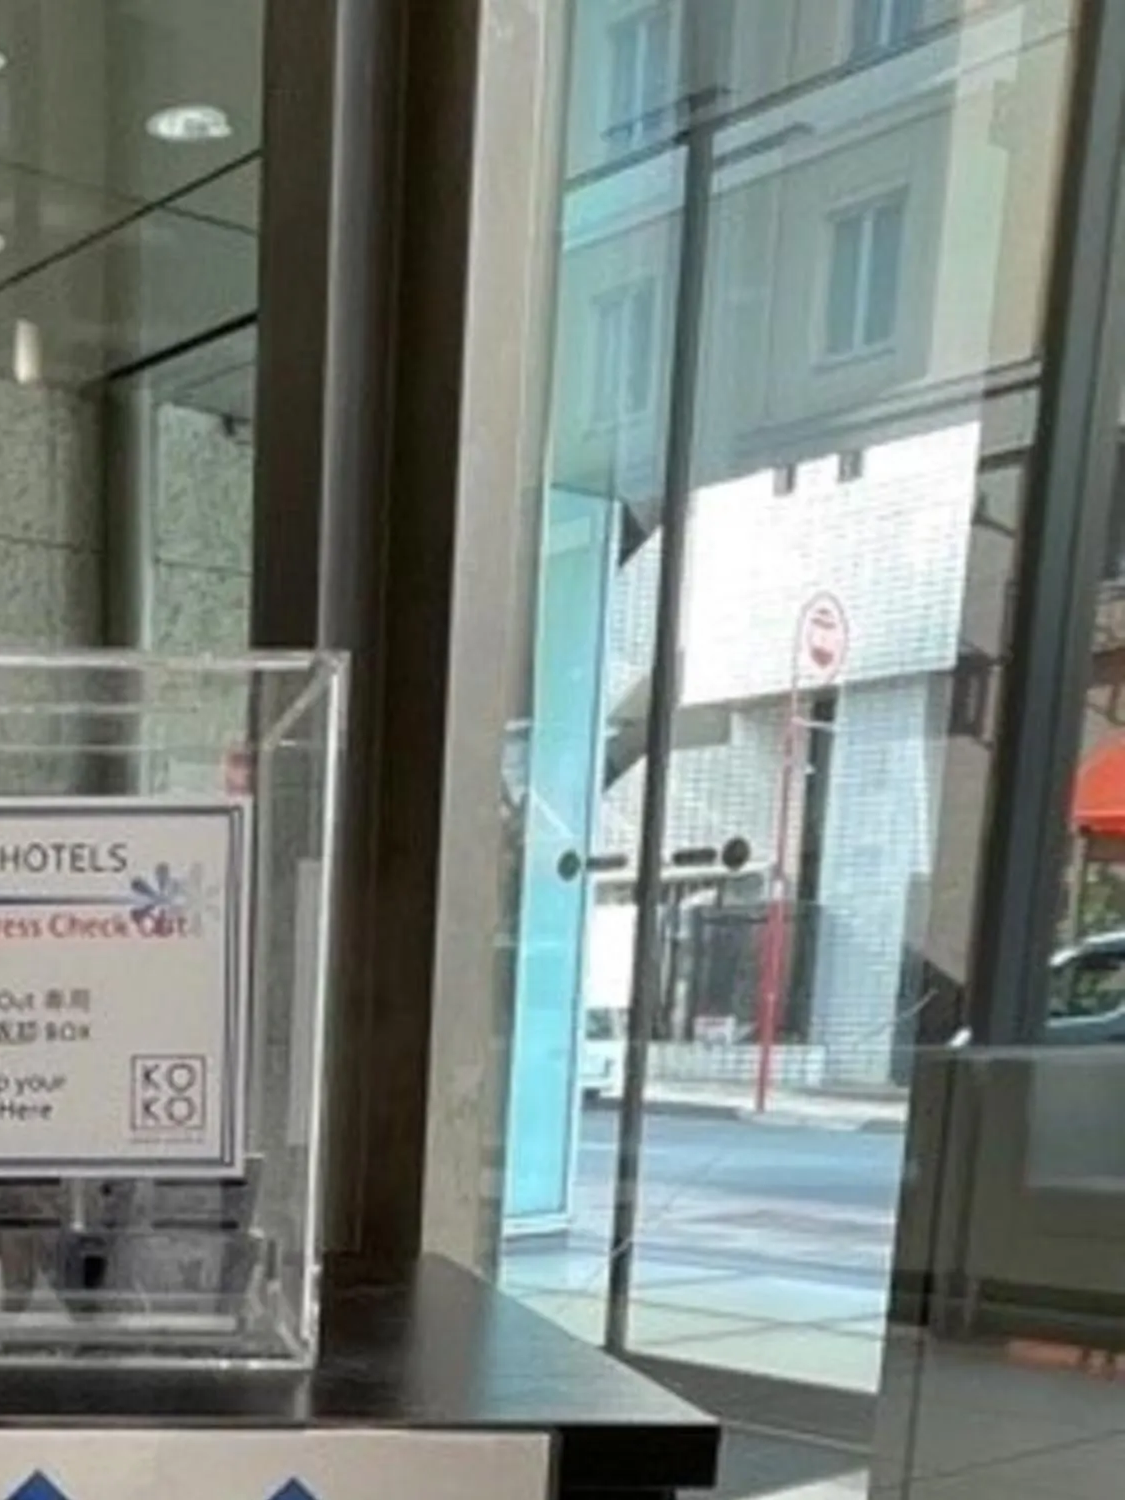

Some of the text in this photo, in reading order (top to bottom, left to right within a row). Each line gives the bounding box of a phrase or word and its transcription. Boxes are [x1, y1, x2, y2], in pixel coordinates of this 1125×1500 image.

[0, 843, 127, 873] HOTELS
[49, 914, 127, 938] Check
[15, 1075, 67, 1097] your
